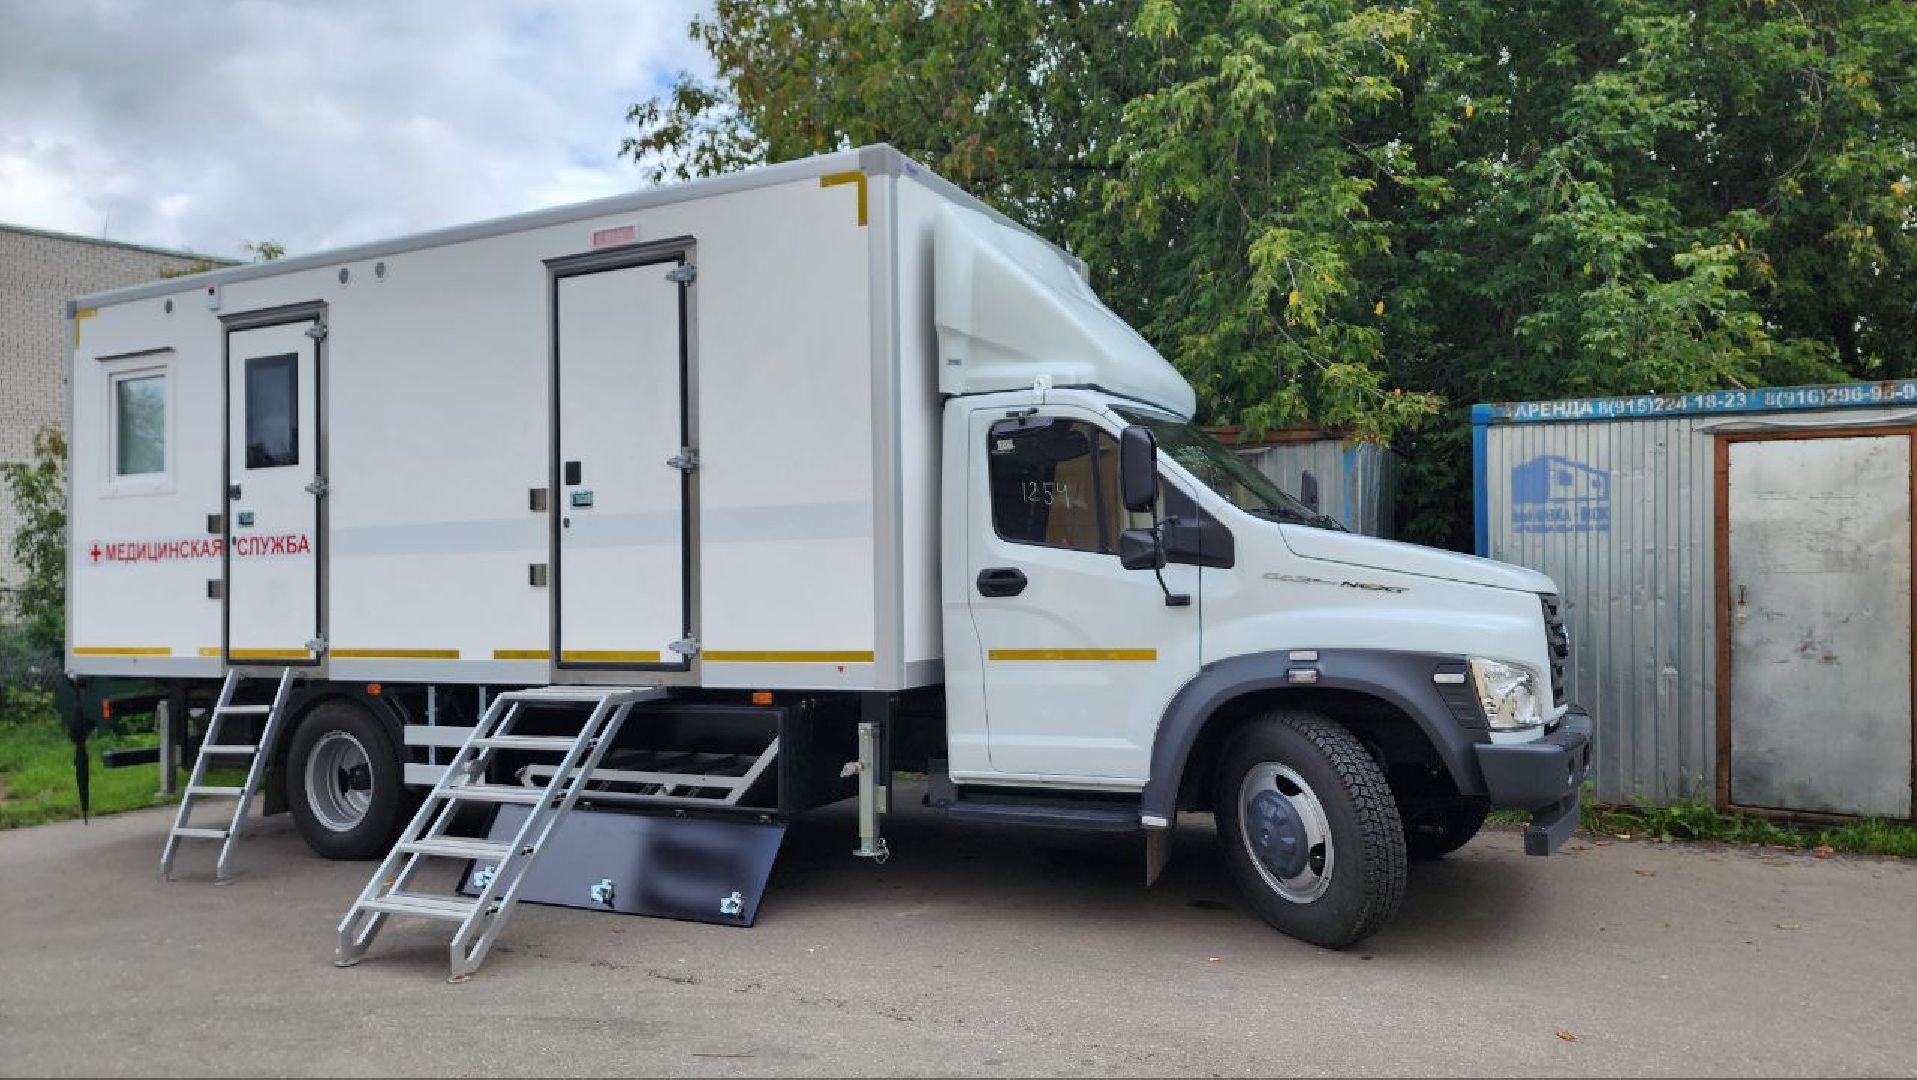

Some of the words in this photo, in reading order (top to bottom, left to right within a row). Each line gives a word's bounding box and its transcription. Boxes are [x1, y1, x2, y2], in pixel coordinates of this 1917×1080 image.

[1514, 400, 1593, 418] АРЕНДА
[1022, 480, 1070, 510] 1254
[105, 537, 226, 564] МЕДИЦИНСКАЯ
[236, 533, 311, 556] СЛУЖБА
